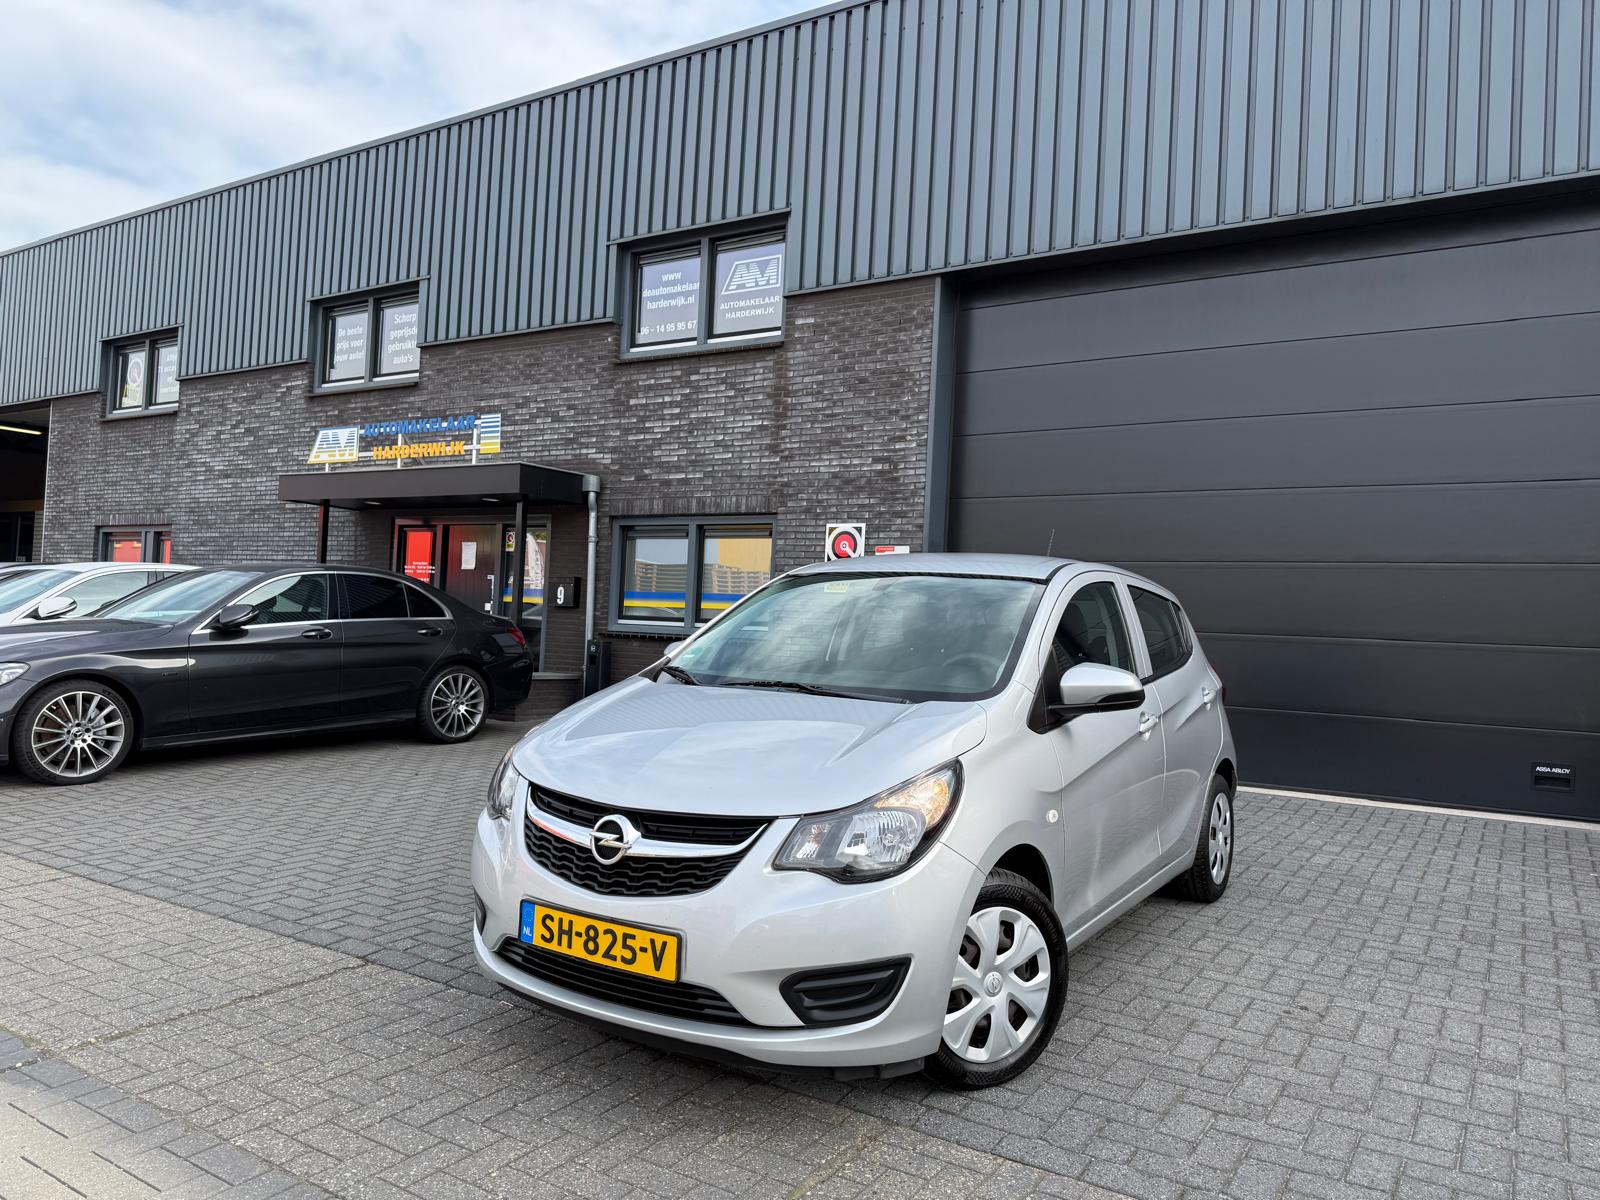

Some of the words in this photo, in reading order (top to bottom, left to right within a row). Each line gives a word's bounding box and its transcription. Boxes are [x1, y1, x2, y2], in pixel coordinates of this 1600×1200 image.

[661, 272, 682, 282] www
[647, 294, 695, 310] harderwijk.nl
[720, 295, 780, 310] AUTOMAKELAAR
[394, 312, 417, 324] Scherp
[725, 306, 775, 319] HARDERWIJK
[640, 326, 650, 335] 06
[656, 324, 665, 333] 14
[666, 322, 676, 332] 95
[676, 321, 687, 331] 95
[687, 320, 697, 330] 67
[363, 415, 476, 437] AUTOMAKELAAR
[373, 441, 465, 460] HARDERWIJK
[556, 586, 565, 605] 9
[522, 926, 532, 937] NL
[540, 913, 668, 972] SH-825-V
